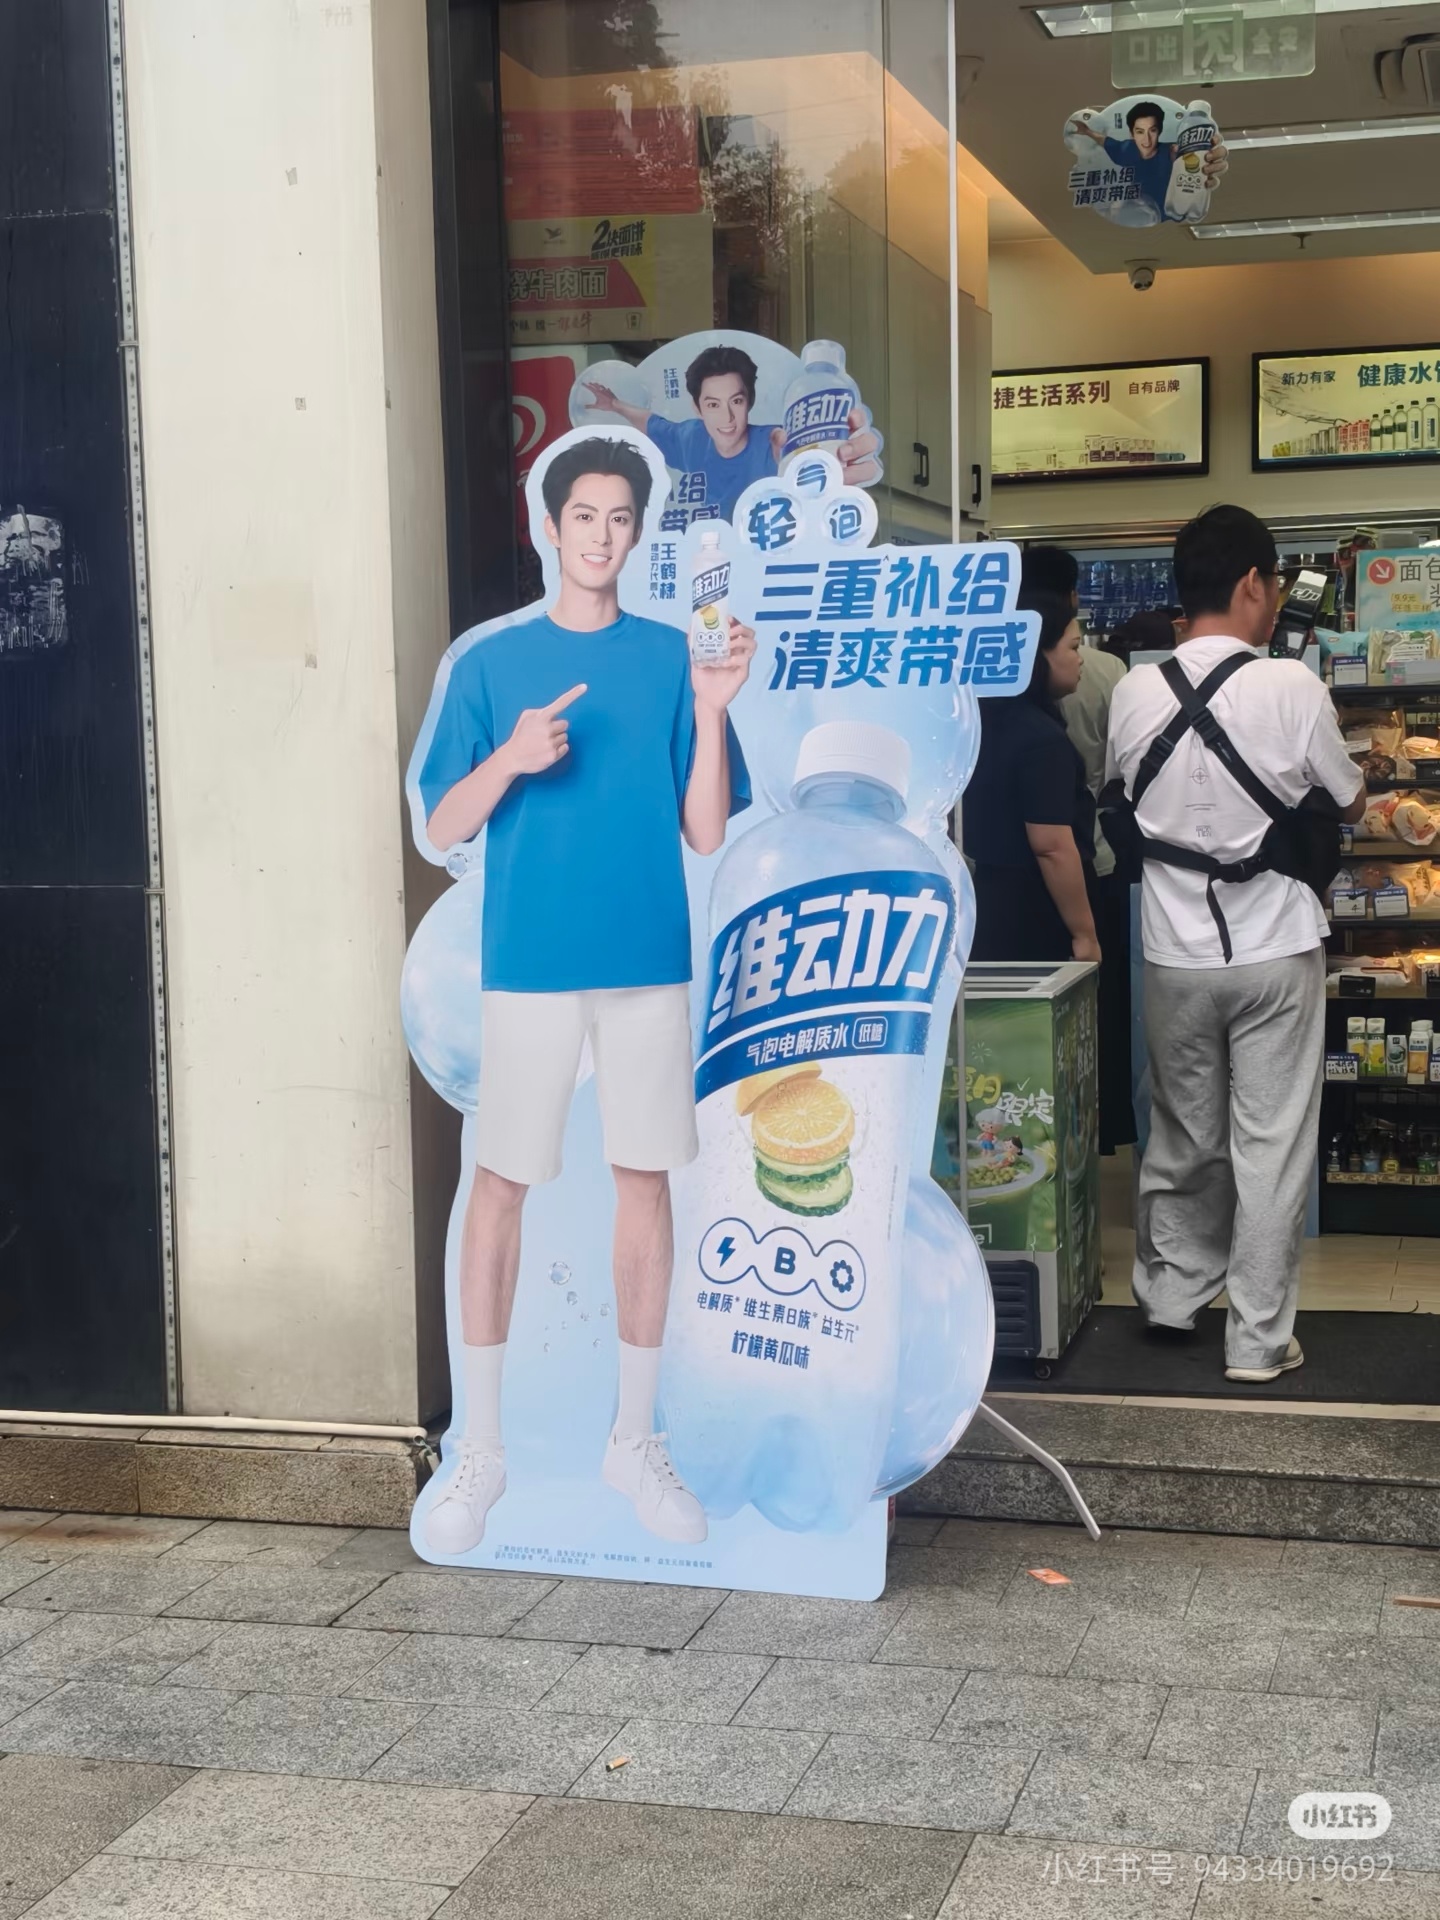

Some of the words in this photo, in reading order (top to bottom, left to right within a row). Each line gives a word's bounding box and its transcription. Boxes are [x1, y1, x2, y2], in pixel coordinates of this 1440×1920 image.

[1069, 166, 1135, 189] 三重补给
[1074, 184, 1140, 206] 清爽带感
[1128, 379, 1181, 395] 自有品牌
[668, 472, 707, 504] 给
[659, 543, 677, 600] 王鹤棣
[768, 621, 1028, 690] 清爽带感
[707, 888, 948, 1035] 维动力
[746, 1022, 849, 1067] 气泡电解质水
[858, 1022, 883, 1044] 低糖
[773, 1246, 796, 1275] B
[730, 1329, 811, 1370] 柠檬黄瓜味
